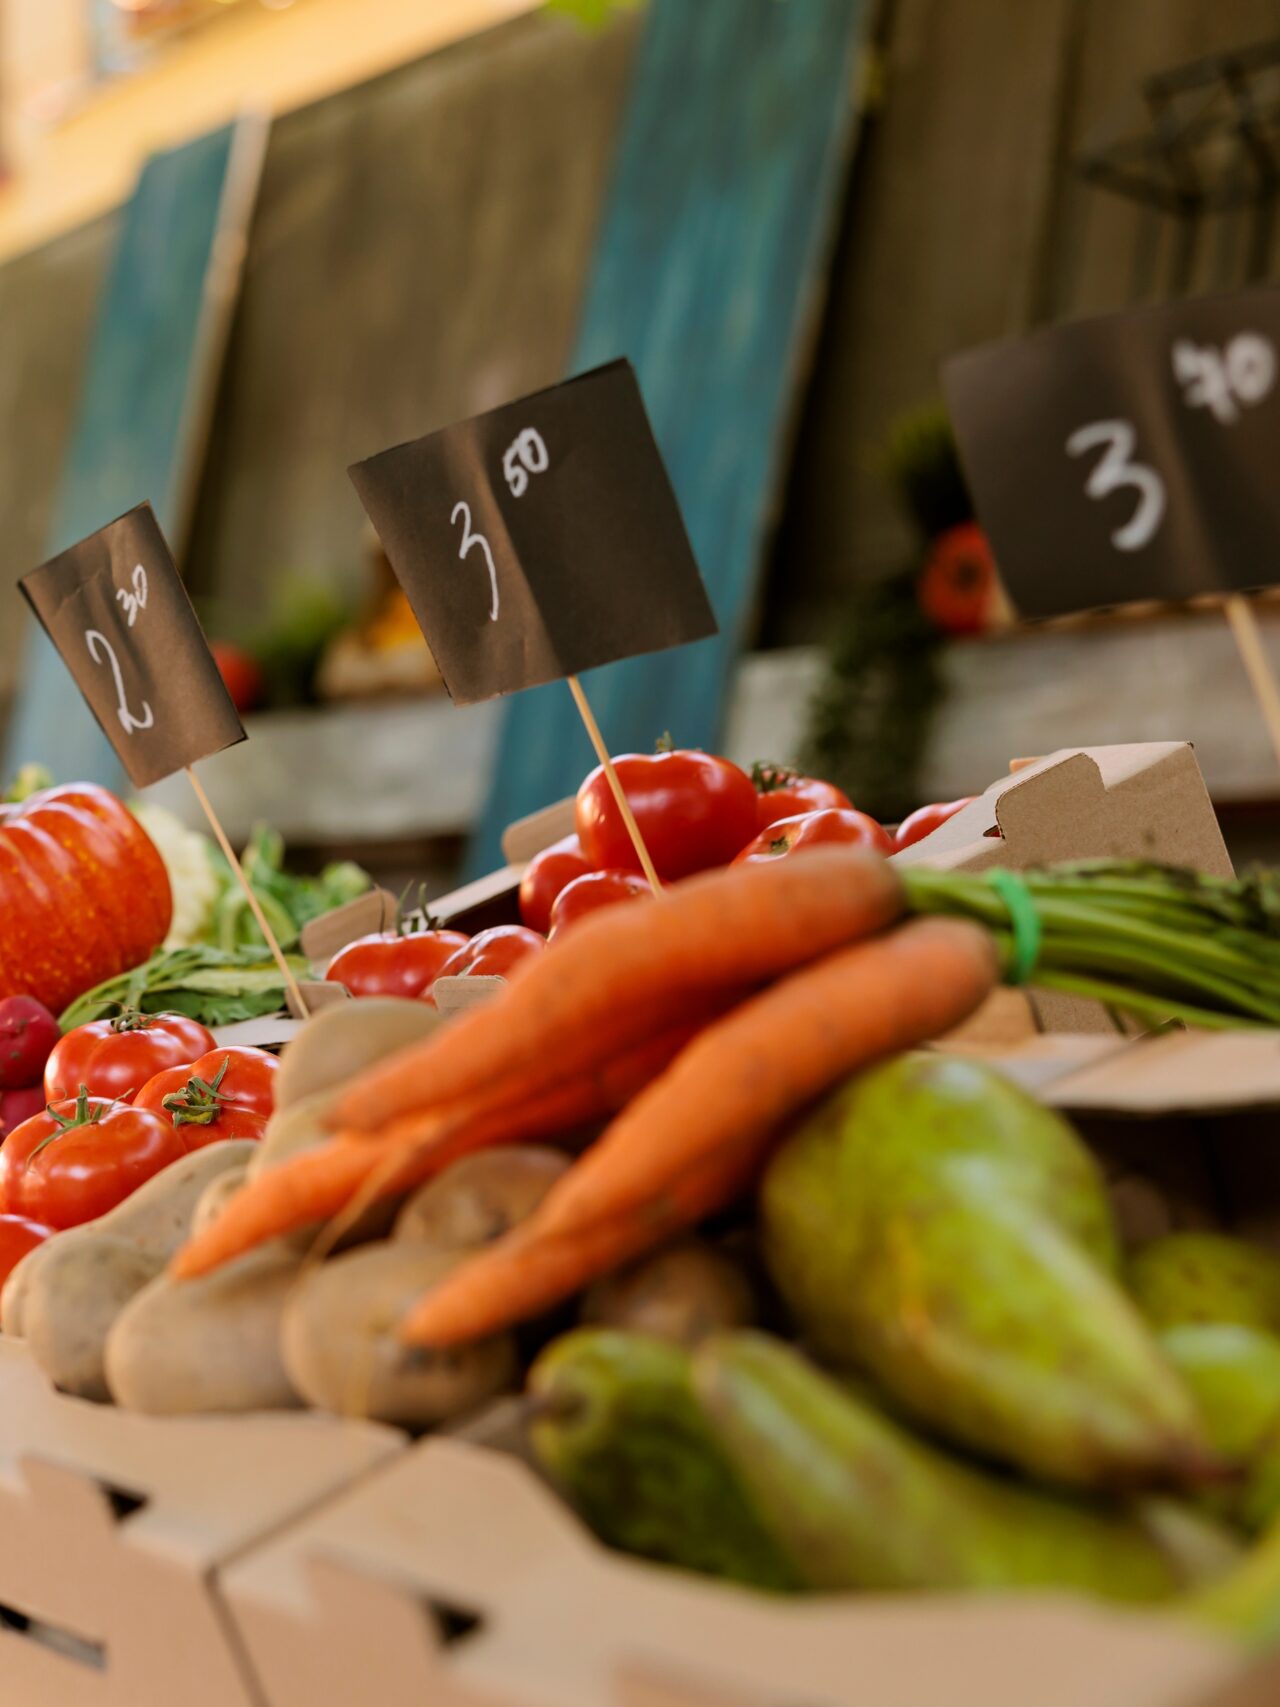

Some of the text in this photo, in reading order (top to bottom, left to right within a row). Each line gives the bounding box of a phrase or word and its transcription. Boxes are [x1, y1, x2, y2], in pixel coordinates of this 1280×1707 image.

[450, 427, 549, 621] 3 50
[1066, 419, 1167, 550] 3
[85, 564, 154, 735] 2 30
